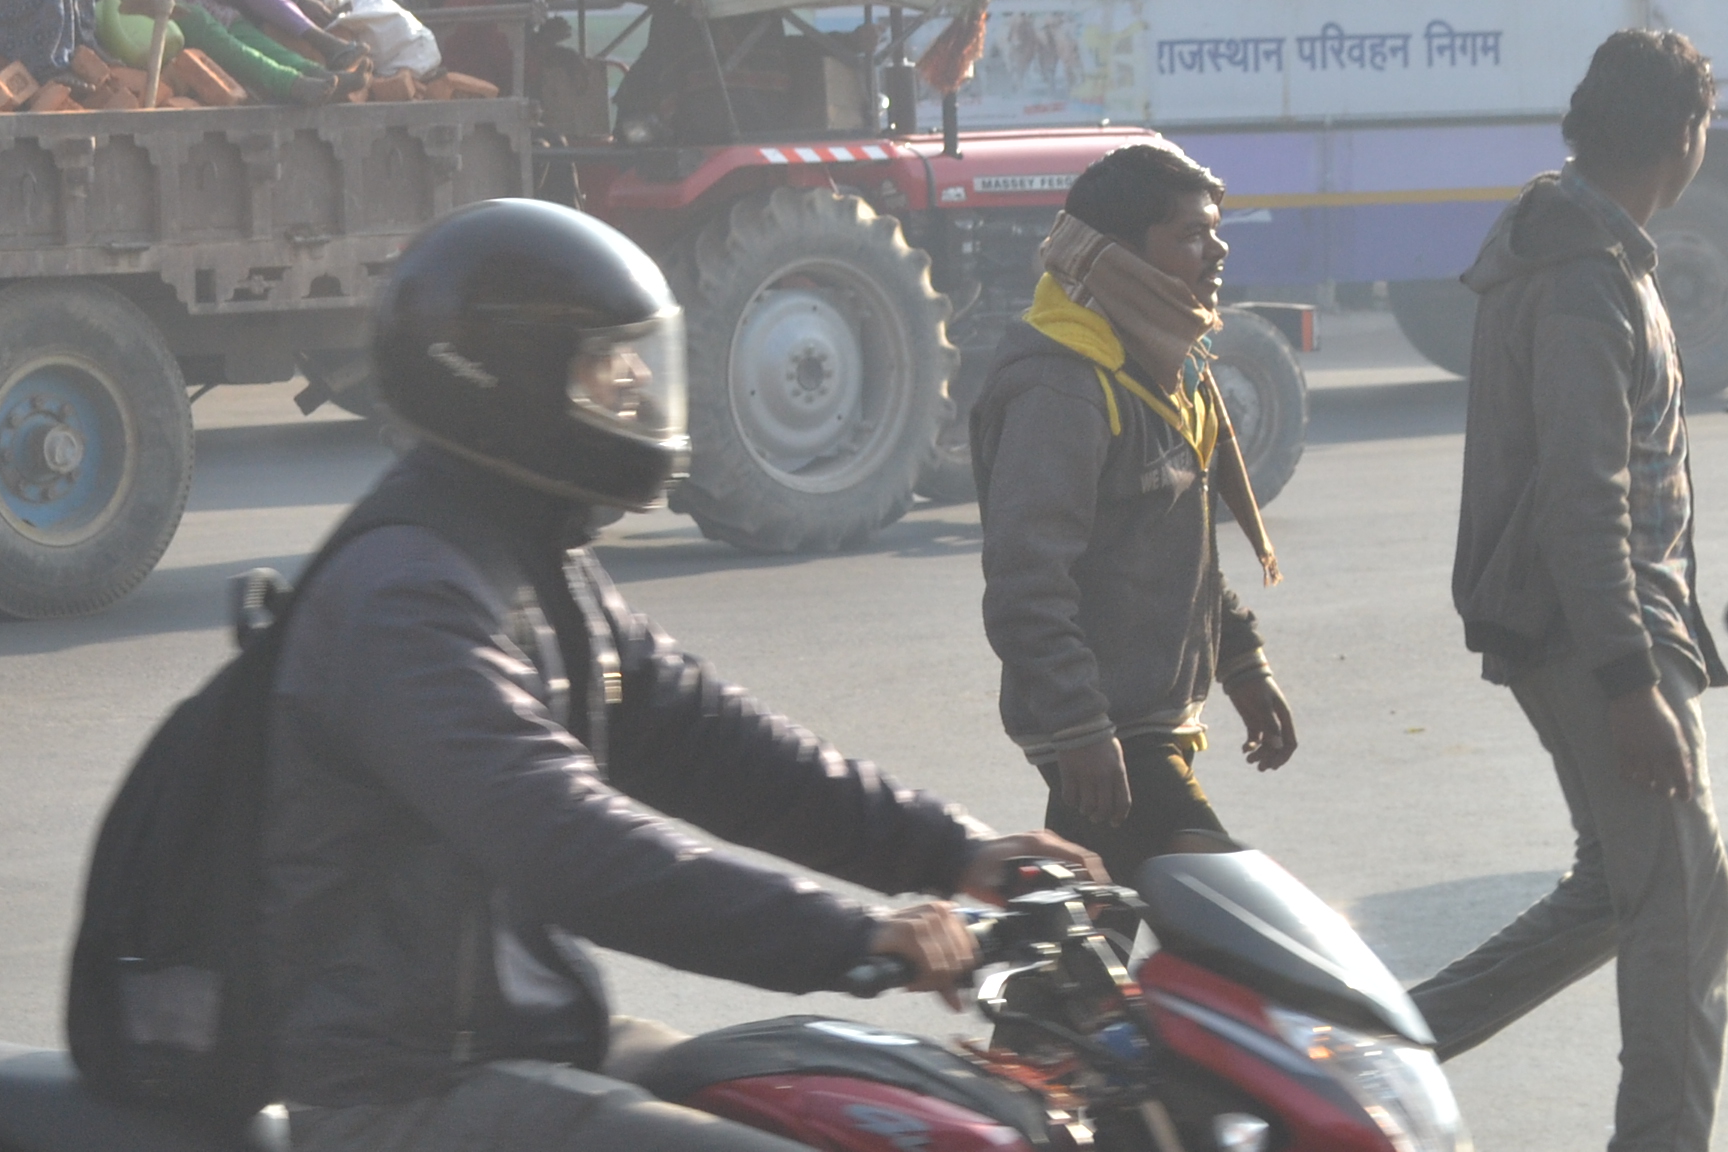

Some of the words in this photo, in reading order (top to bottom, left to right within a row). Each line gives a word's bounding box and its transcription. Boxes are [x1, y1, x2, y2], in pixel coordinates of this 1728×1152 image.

[1156, 36, 1287, 75] राजस्थान
[1295, 21, 1413, 72] परिवहन
[1422, 19, 1504, 68] निगम
[980, 177, 1035, 191] MASSEY
[1039, 175, 1074, 189] FERG
